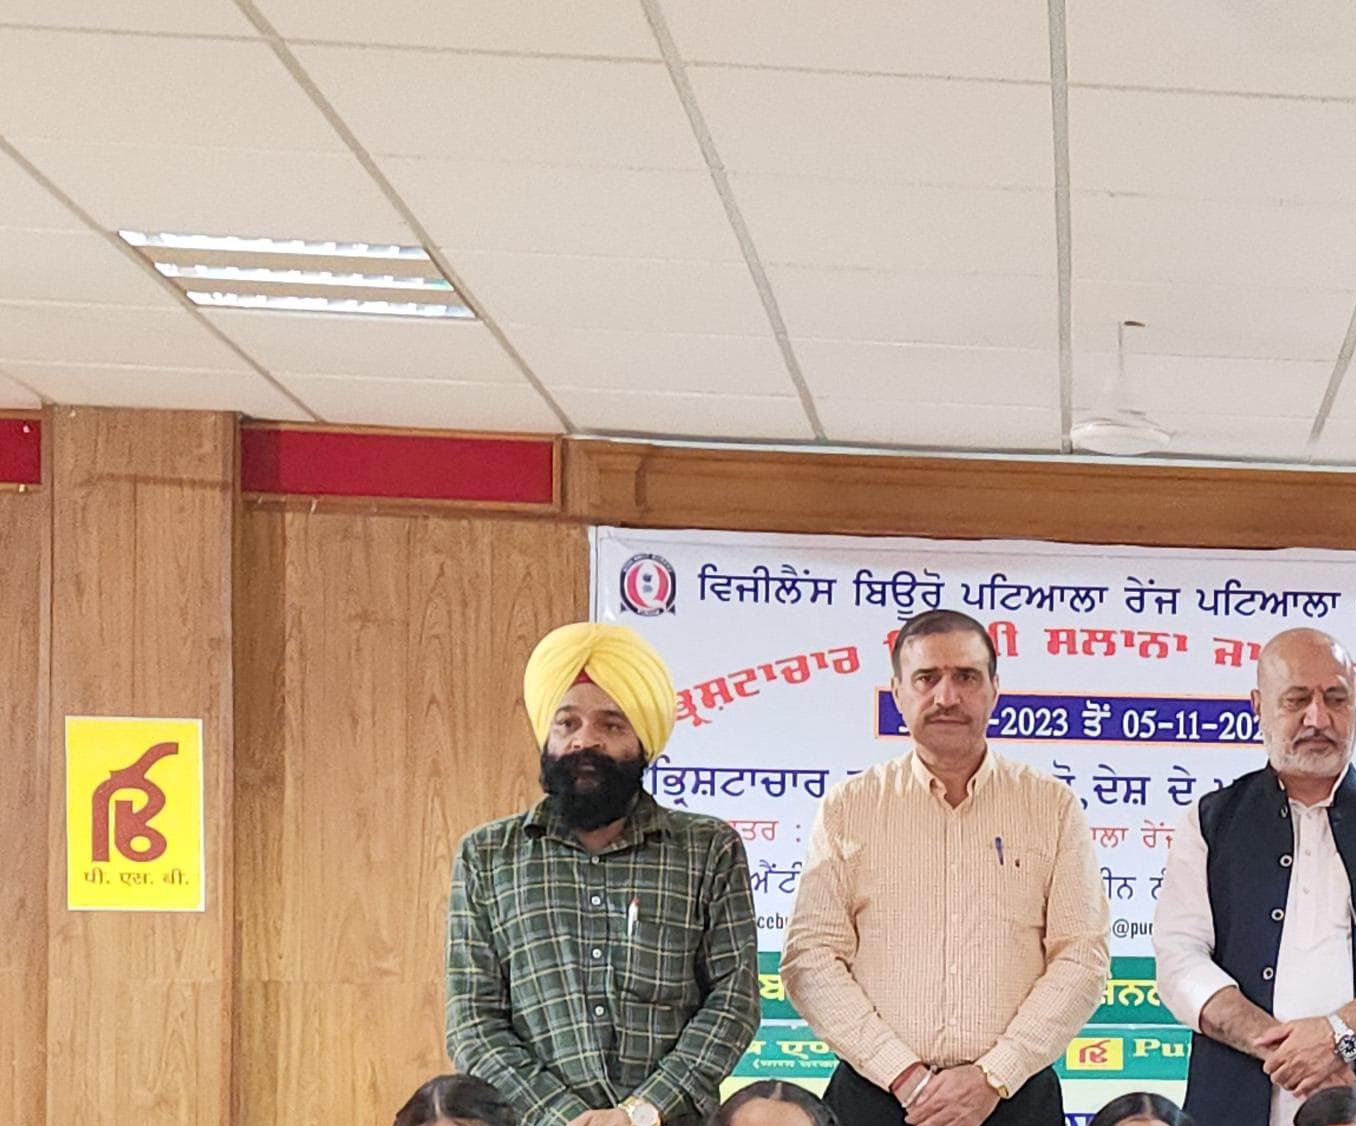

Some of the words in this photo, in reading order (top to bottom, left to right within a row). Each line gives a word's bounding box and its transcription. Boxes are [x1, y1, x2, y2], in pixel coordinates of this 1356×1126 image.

[698, 563, 837, 605] ਵਿਜੀਲੈਂਸ
[853, 568, 945, 621] ਬਿਊਰੋ
[961, 573, 1108, 612] ਪਟਿਆਲਾ
[1124, 576, 1181, 614] ਰੇਂਜ
[1196, 579, 1341, 618] ਪਟਿਆਲਾ
[1044, 628, 1188, 658] ਸਲਾਨਾ
[1082, 700, 1111, 737] ਤੋਂ
[1123, 709, 1264, 740] 05-11-202
[649, 755, 829, 808] ਭ੍ਰਿਸ਼ਟਾਚਾਰ
[1167, 765, 1196, 806] ਦੇ
[84, 867, 110, 885] पी.
[120, 871, 154, 886] एस.
